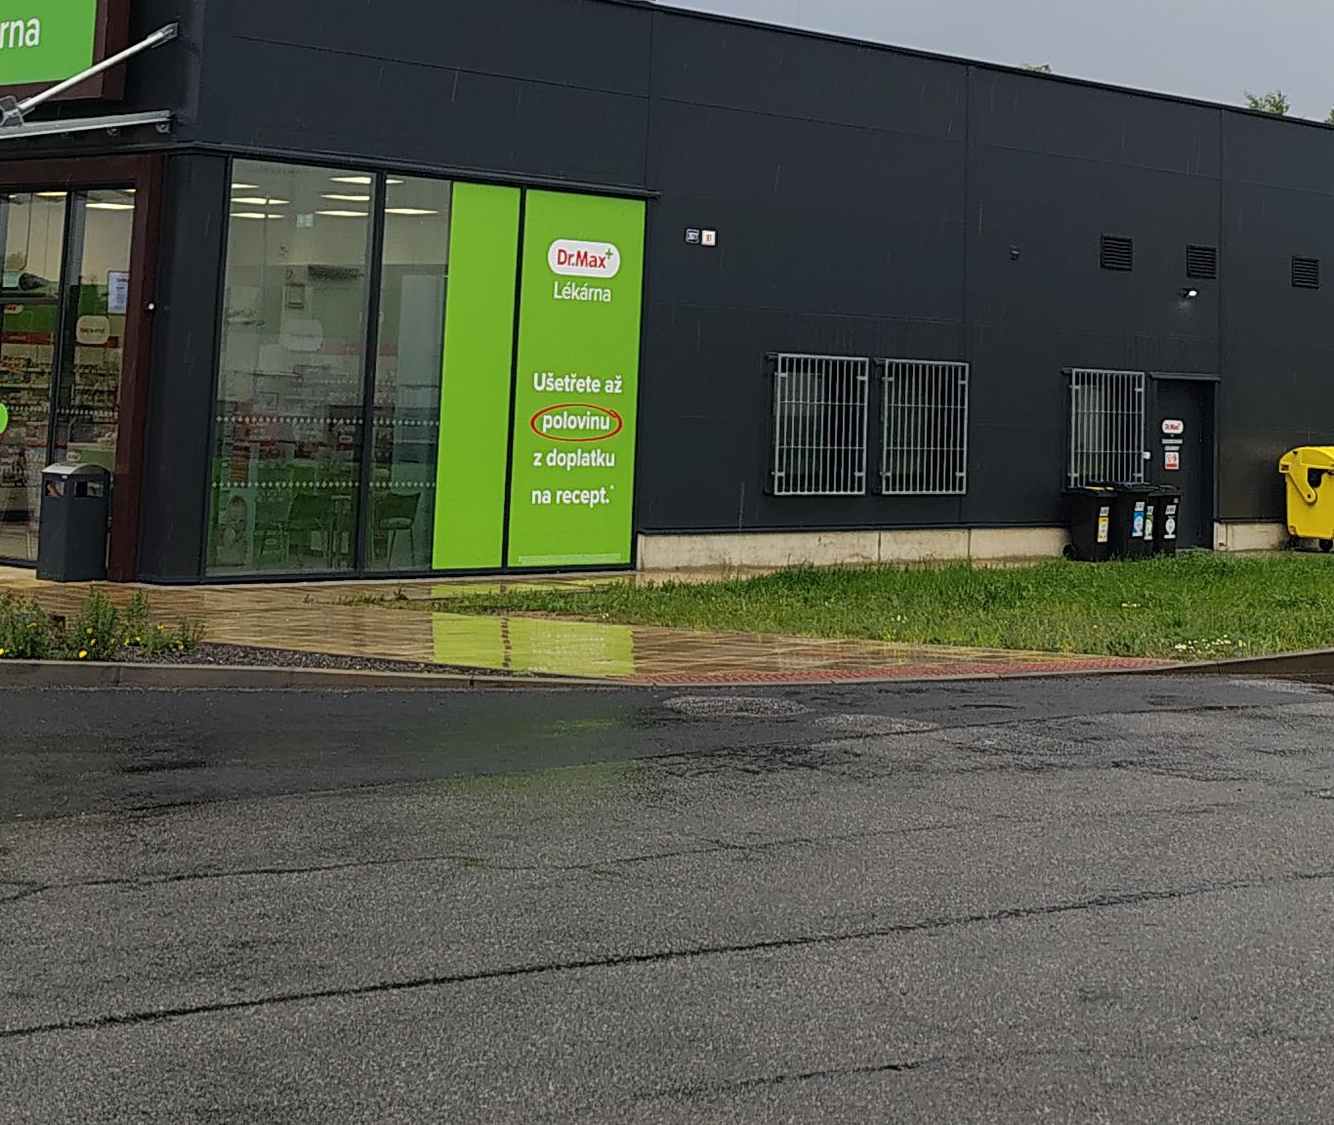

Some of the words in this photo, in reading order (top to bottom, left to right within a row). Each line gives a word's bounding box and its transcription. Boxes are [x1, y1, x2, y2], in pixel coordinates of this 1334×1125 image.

[554, 281, 612, 302] Lékárna
[533, 372, 601, 394] Ušetřete
[604, 375, 622, 394] až
[542, 411, 611, 434] polovinu
[533, 452, 543, 467] z
[546, 448, 616, 471] doplatku
[531, 489, 552, 505] na
